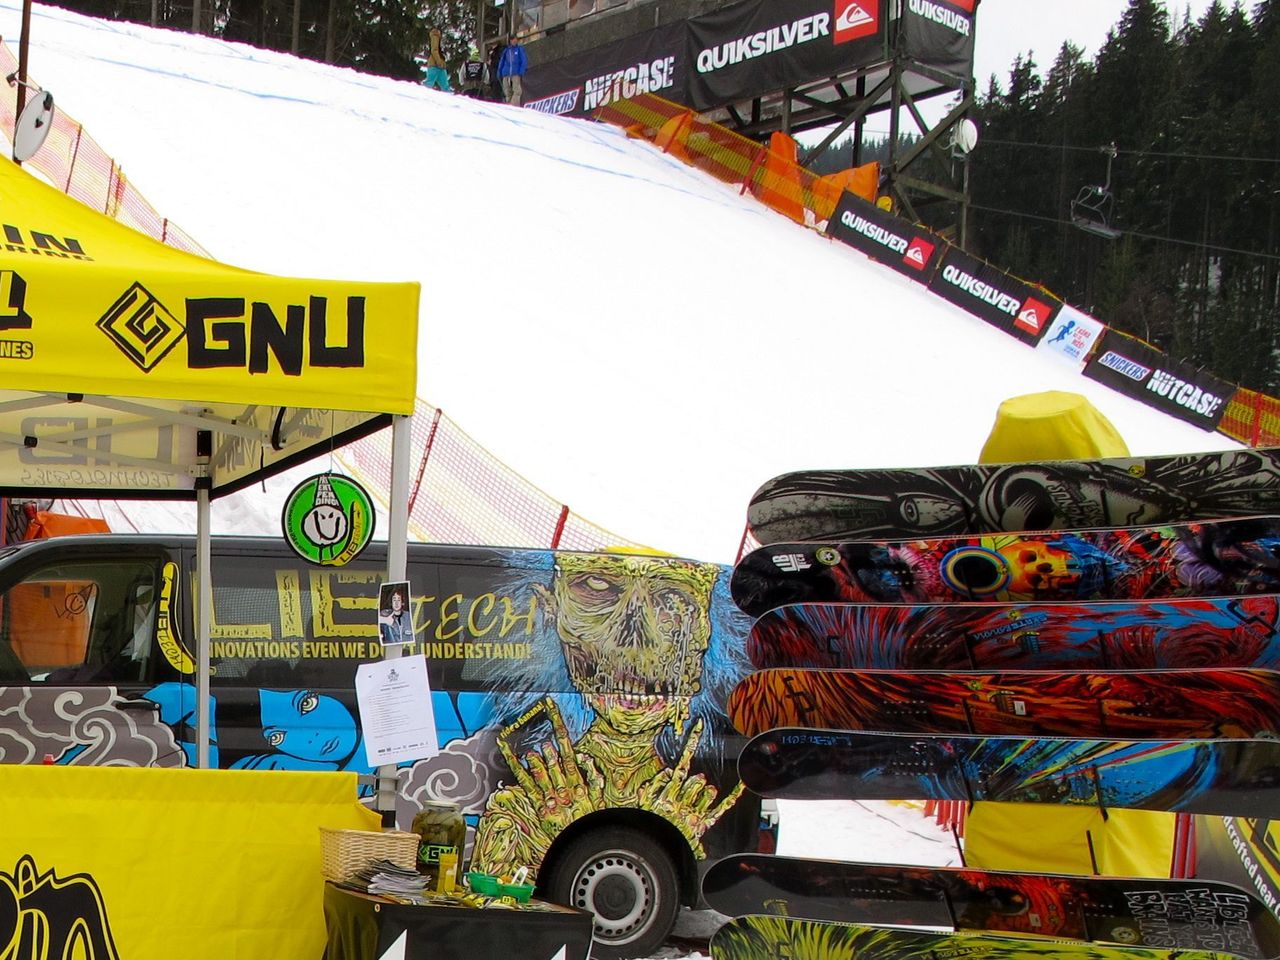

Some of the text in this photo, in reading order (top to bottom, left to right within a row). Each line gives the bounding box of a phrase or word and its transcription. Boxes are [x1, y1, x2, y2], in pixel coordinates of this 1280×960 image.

[697, 12, 829, 73] QUIKSILVER
[907, 0, 970, 36] QUIKSILVER
[524, 56, 675, 113] SNICKERS NUTCASE
[841, 210, 909, 254] QUIKSILVER
[942, 264, 1020, 317] QUIKSILVER
[185, 295, 366, 376] GNU
[1100, 352, 1222, 417] SNICKERS NUTCASE
[410, 592, 538, 641] TECH
[209, 641, 302, 659] NOVATIONS
[303, 642, 340, 659] EVEN
[342, 642, 365, 659] WE
[422, 642, 531, 660] UNDERSTAND!
[1254, 874, 1277, 908] near
